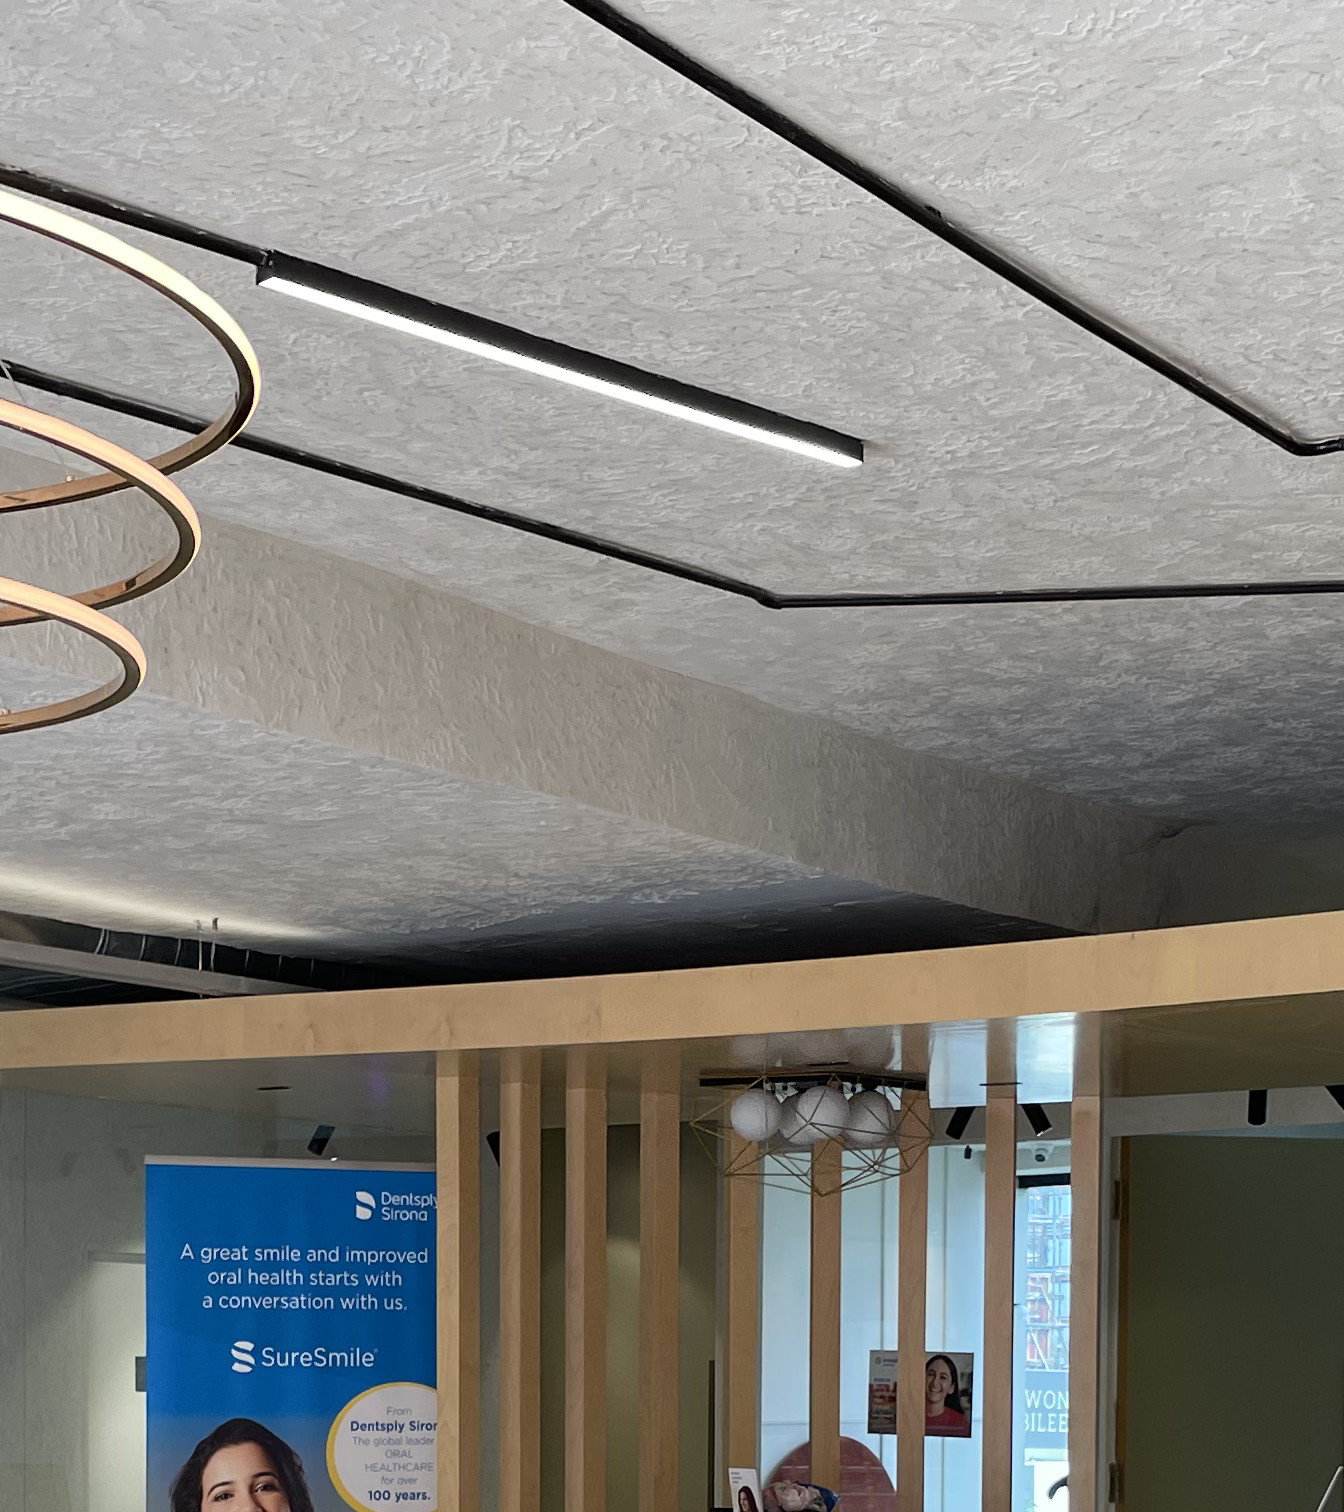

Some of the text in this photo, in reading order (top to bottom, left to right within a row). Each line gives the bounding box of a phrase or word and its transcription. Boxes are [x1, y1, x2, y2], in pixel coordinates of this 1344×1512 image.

[381, 1191, 437, 1209] Dentsply
[381, 1206, 428, 1221] Sirona
[179, 1243, 429, 1265] A great smile and improved
[207, 1268, 403, 1287] oral health starts with
[202, 1293, 408, 1311] a conversation with us.
[261, 1347, 376, 1368] SureSmile
[386, 1406, 413, 1416] From
[350, 1420, 405, 1433] Dentsply
[352, 1436, 435, 1447] The global leader
[384, 1449, 414, 1459] ORAL
[364, 1462, 434, 1472] HEALTHCARE
[380, 1475, 418, 1485] for over
[367, 1490, 431, 1503] 100 years.
